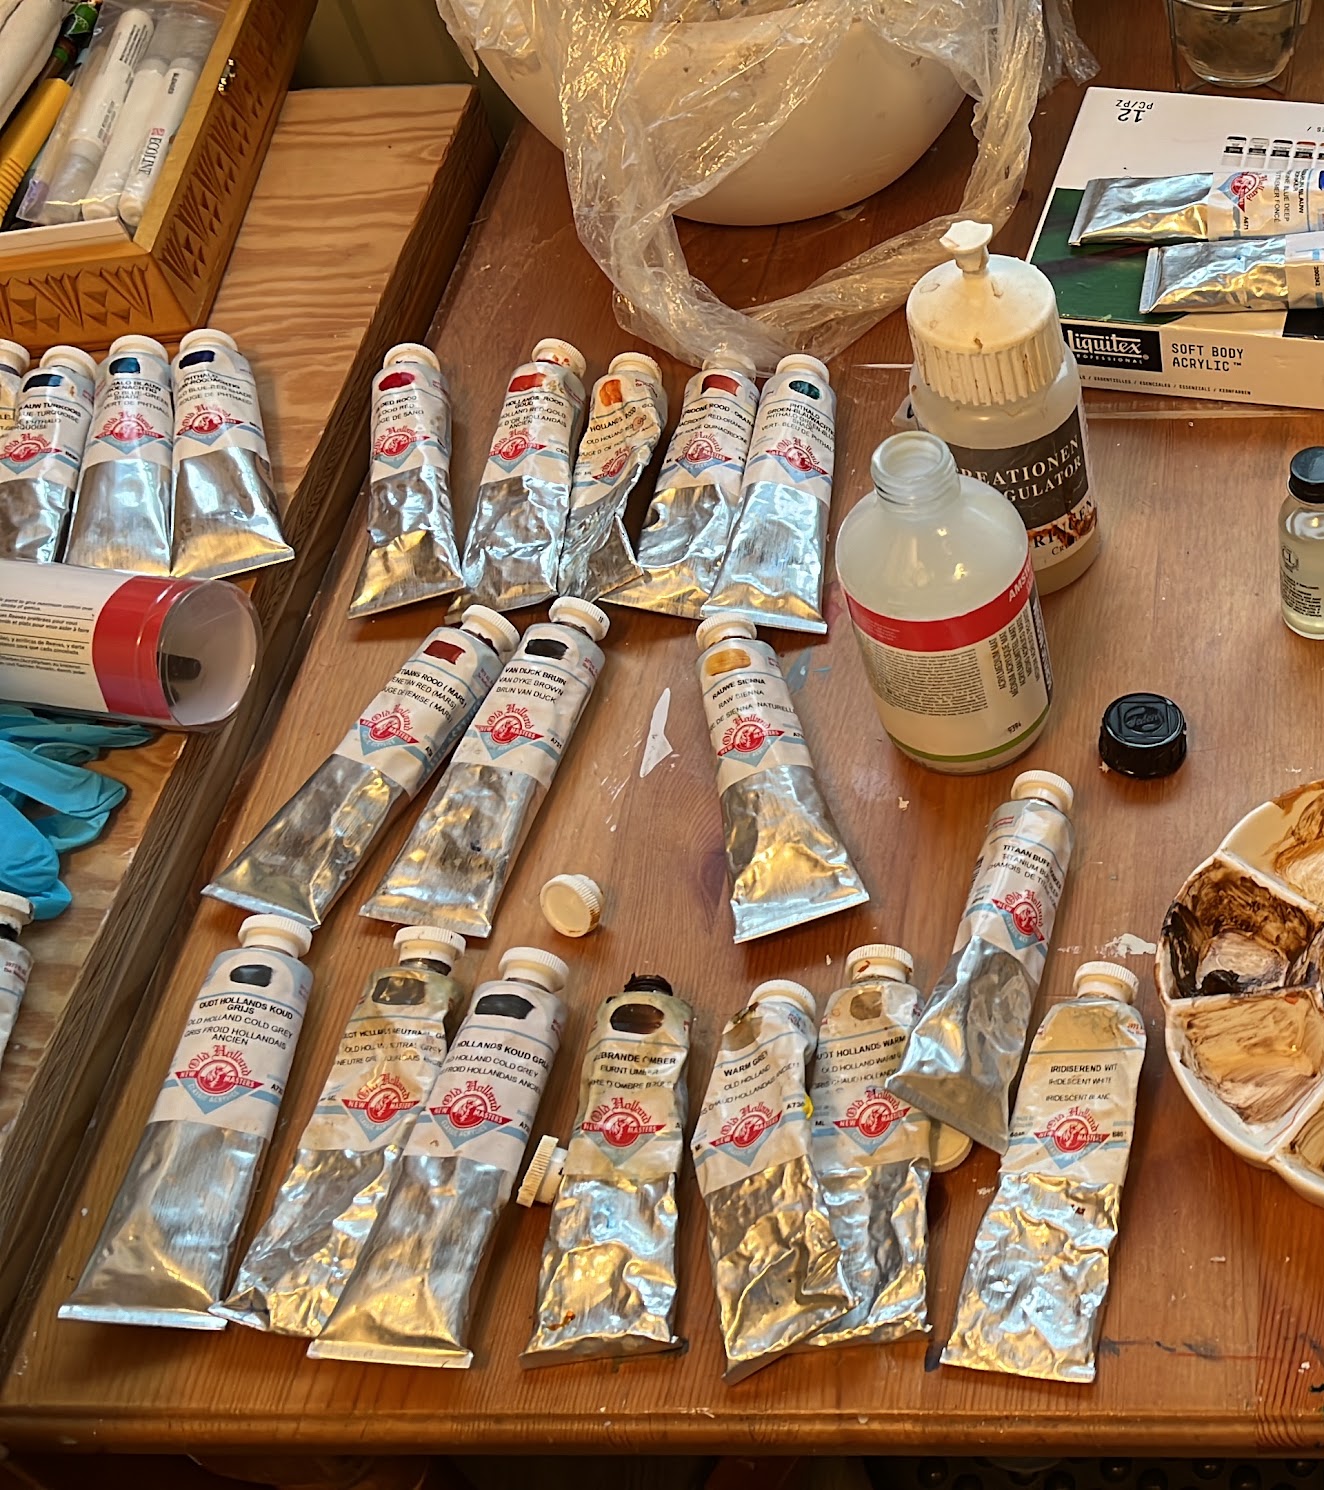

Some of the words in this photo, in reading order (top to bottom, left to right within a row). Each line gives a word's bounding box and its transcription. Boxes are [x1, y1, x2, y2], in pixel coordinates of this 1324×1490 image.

[1115, 99, 1153, 110] PC/PZ
[1117, 108, 1145, 123] 12
[1067, 330, 1143, 355] Liquitex
[1171, 342, 1204, 357] SOFT
[1212, 346, 1244, 359] BODY
[1093, 376, 1132, 385] ESSENTIELLES
[1139, 379, 1171, 388] ESENCIALES
[1179, 383, 1211, 392] ESSENZIALI
[505, 395, 540, 408] HOLLANDS
[542, 396, 564, 407] ROOD
[515, 401, 534, 409] GOUD
[709, 402, 731, 412] ROOD
[403, 409, 425, 417] SANG
[509, 419, 533, 429] ANCIEN
[590, 416, 624, 433] HOLLANDS
[707, 413, 747, 433] RED-ORANGE
[586, 437, 599, 445] OLD
[600, 429, 624, 443] HOLLAND
[703, 423, 748, 444] QUINACRIDONE
[999, 631, 1008, 644] MAT
[1001, 645, 1016, 673] ACRYLIQUE
[422, 672, 444, 689] ROOD
[518, 668, 541, 677] DIJCK
[542, 670, 567, 685] BRUIN
[416, 682, 432, 694] RED
[498, 676, 514, 684] VAN
[515, 677, 533, 686] DYKE
[533, 680, 564, 696] BROWN
[712, 680, 736, 700] RAUWE
[1008, 673, 1019, 697] MÉDIUM
[496, 686, 515, 694] BRUN
[515, 688, 532, 696] VAN
[533, 691, 557, 703] DIJCK
[718, 694, 734, 709] RAW
[735, 689, 765, 700] SIENNA
[715, 715, 725, 725] DE
[726, 704, 753, 718] SIENNA
[732, 714, 771, 729] Holland
[1003, 844, 1033, 857] TITAAN
[1002, 852, 1039, 871] TITANIUM
[199, 998, 219, 1009] OUDT
[219, 996, 268, 1011] HOLLANDS
[269, 1005, 293, 1020] KOUD
[227, 1004, 255, 1015] GRIJS
[187, 1016, 203, 1026] OLD
[204, 1013, 242, 1023] HOLLAND
[244, 1017, 270, 1030] COLD
[271, 1025, 294, 1040] GREY
[184, 1029, 201, 1037] GRIS
[202, 1026, 230, 1035] FROID
[231, 1028, 287, 1050] HOLLANDAIS
[211, 1034, 249, 1045] ANCIEN
[835, 1041, 882, 1057] HOLLANDS
[883, 1035, 907, 1047] WARM
[188, 1052, 211, 1070] Old
[213, 1044, 251, 1077] Holland
[504, 1046, 532, 1060] KOUD
[455, 1055, 492, 1063] HOLLAND
[493, 1057, 516, 1070] COLD
[517, 1064, 539, 1078] GREY
[600, 1065, 627, 1075] BURNT
[724, 1062, 751, 1077] WARM
[821, 1065, 838, 1074] OLD
[840, 1059, 875, 1072] HOLLAND
[1050, 1064, 1102, 1073] IRIDISEREND
[1104, 1063, 1118, 1071] WIT
[224, 1075, 255, 1087] MASTERS
[466, 1067, 518, 1083] HOLLANDAIS
[724, 1080, 739, 1090] OLD
[740, 1064, 771, 1085] HOLLAND
[1048, 1077, 1091, 1085] IRIDESCENT
[442, 1088, 462, 1106] Old
[465, 1080, 501, 1111] Holland
[1088, 1093, 1110, 1101] BLANC
[474, 1109, 503, 1124] MASTERS
[590, 1104, 611, 1122] Old
[611, 1097, 651, 1124] Holland
[838, 1119, 857, 1127] NEW
[1069, 1106, 1099, 1132] Holland
